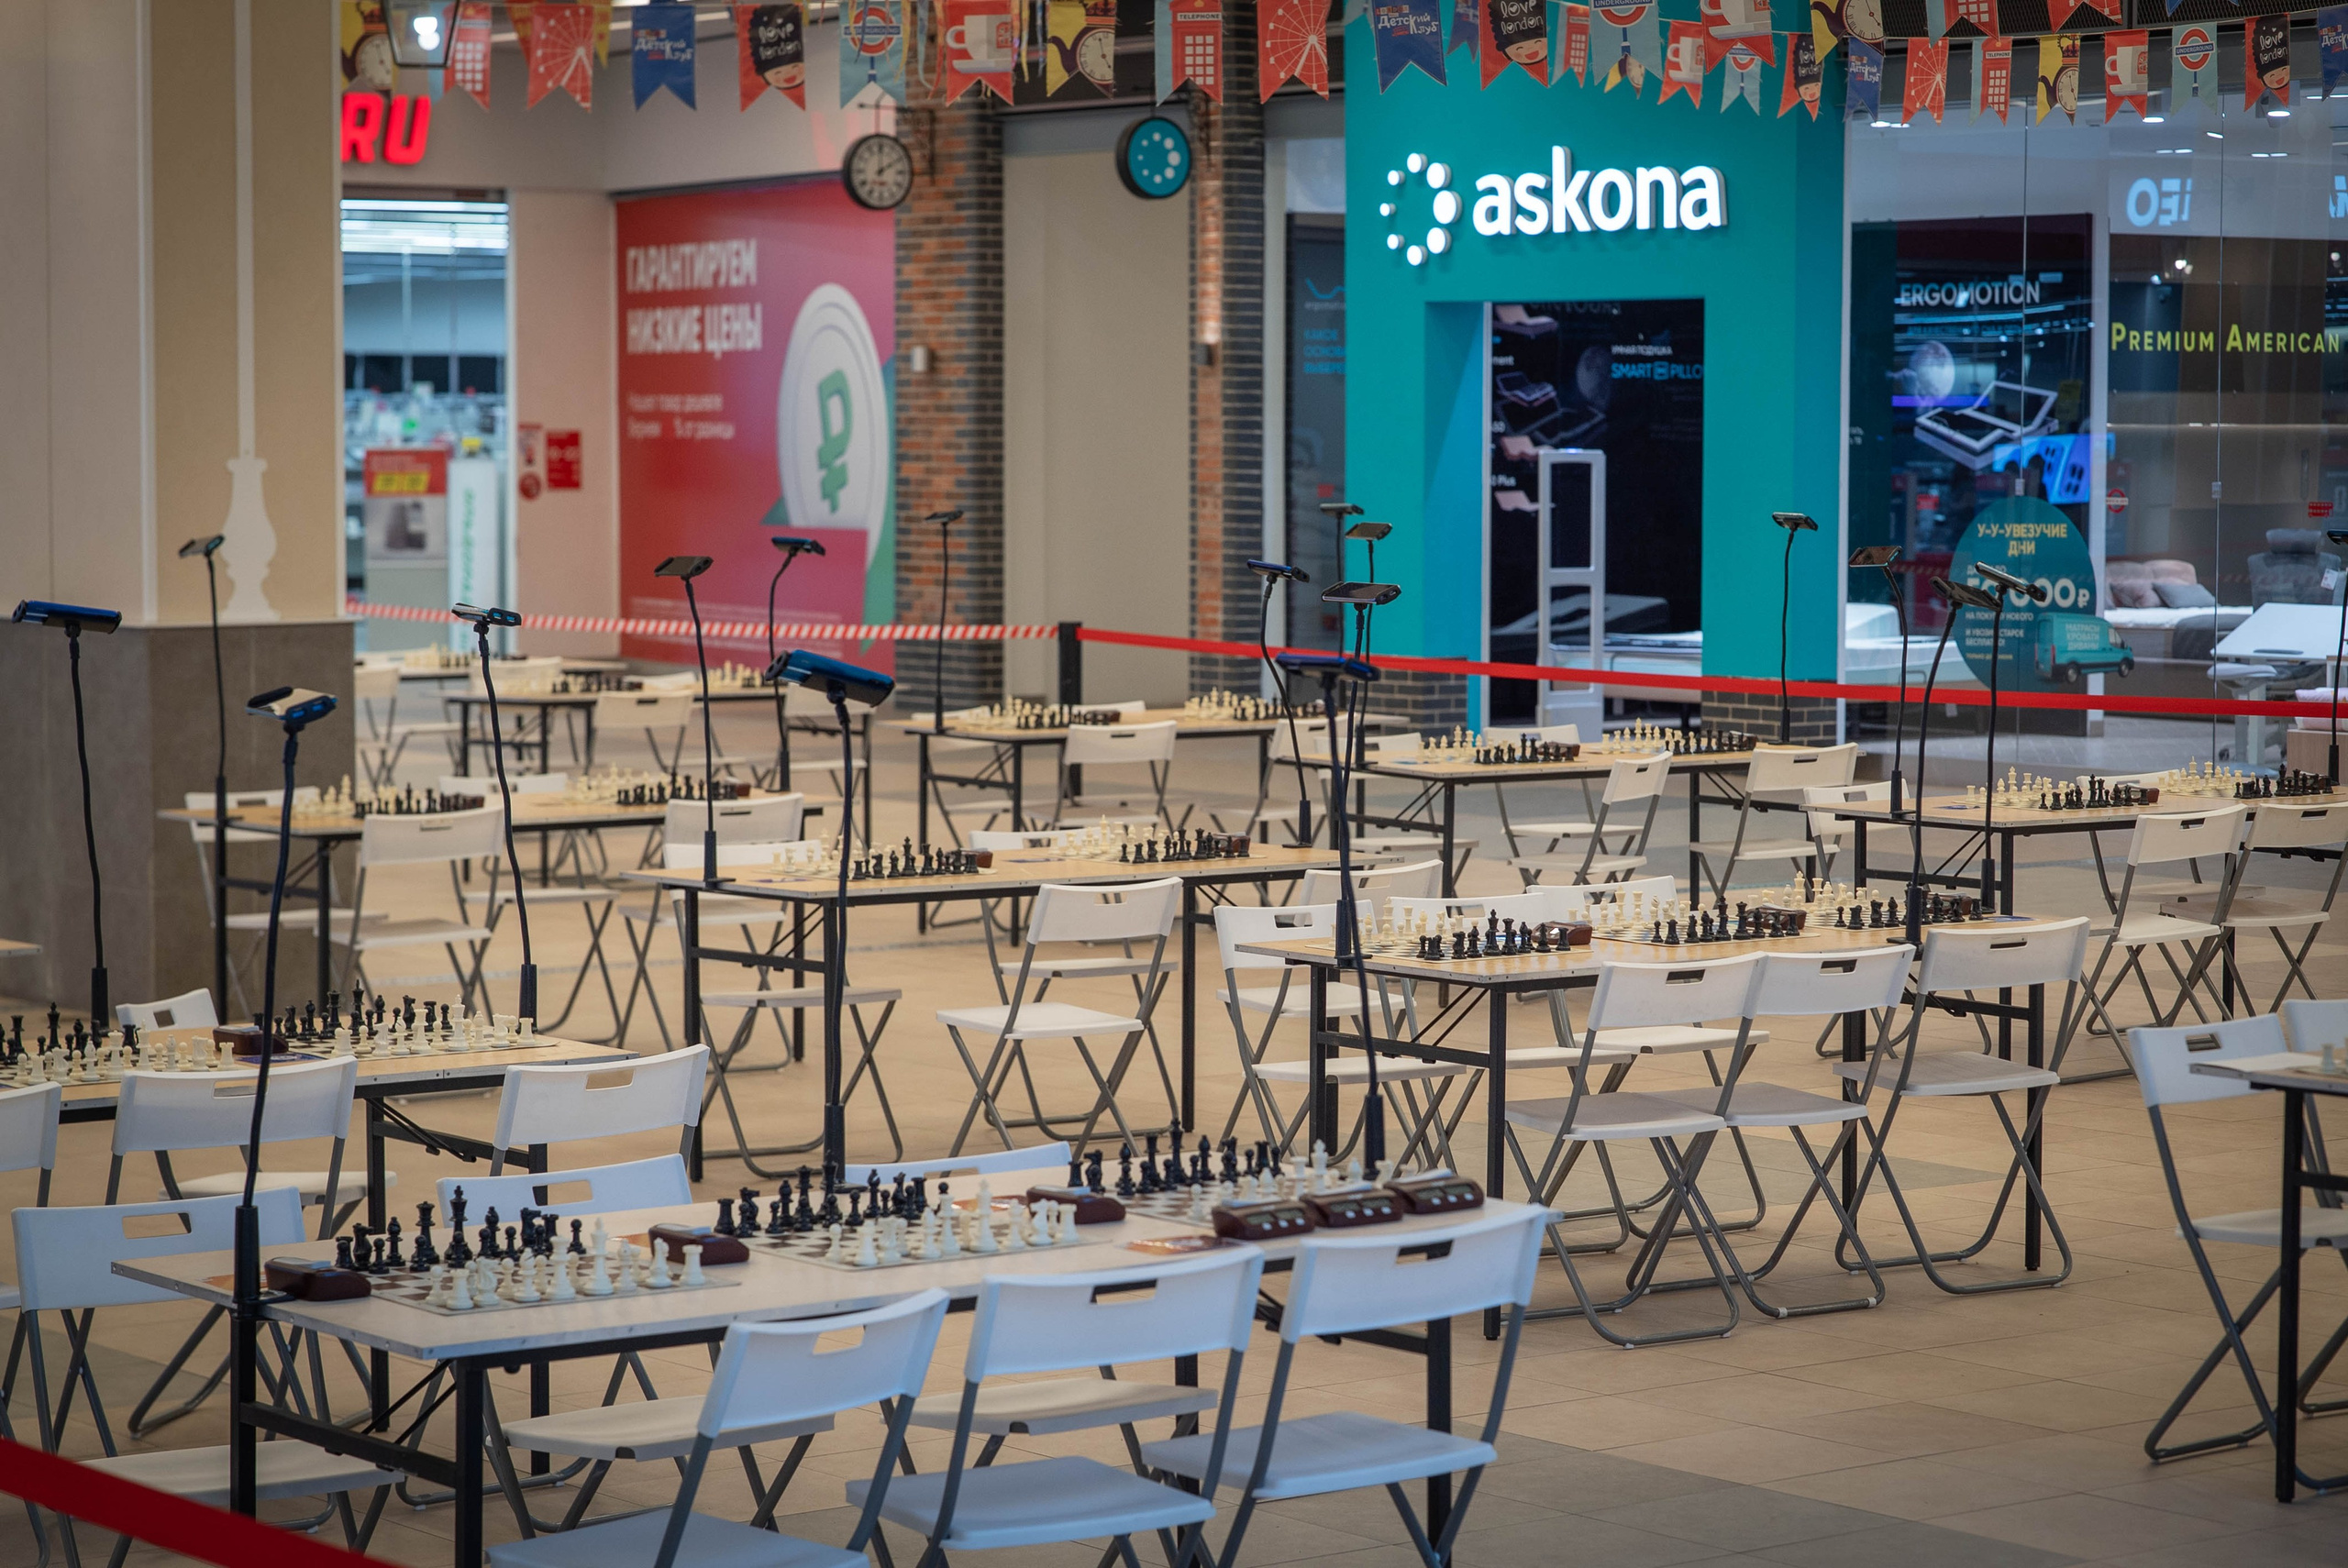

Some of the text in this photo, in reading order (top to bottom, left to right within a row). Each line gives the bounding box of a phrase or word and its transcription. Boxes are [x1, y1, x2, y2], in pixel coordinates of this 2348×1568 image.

[1501, 16, 1544, 35] london
[1473, 146, 1725, 236] askona
[626, 239, 757, 293] ГАРАНТИРУЕМ
[1899, 281, 2040, 306] ERGOMOTION
[626, 303, 762, 359] НИЗКИЕ ЦЕНЫ
[1611, 362, 1651, 379] SMART
[1977, 524, 2067, 538] У-У-УВЕЗУЧИЕ
[2008, 540, 2035, 557] ДНИ
